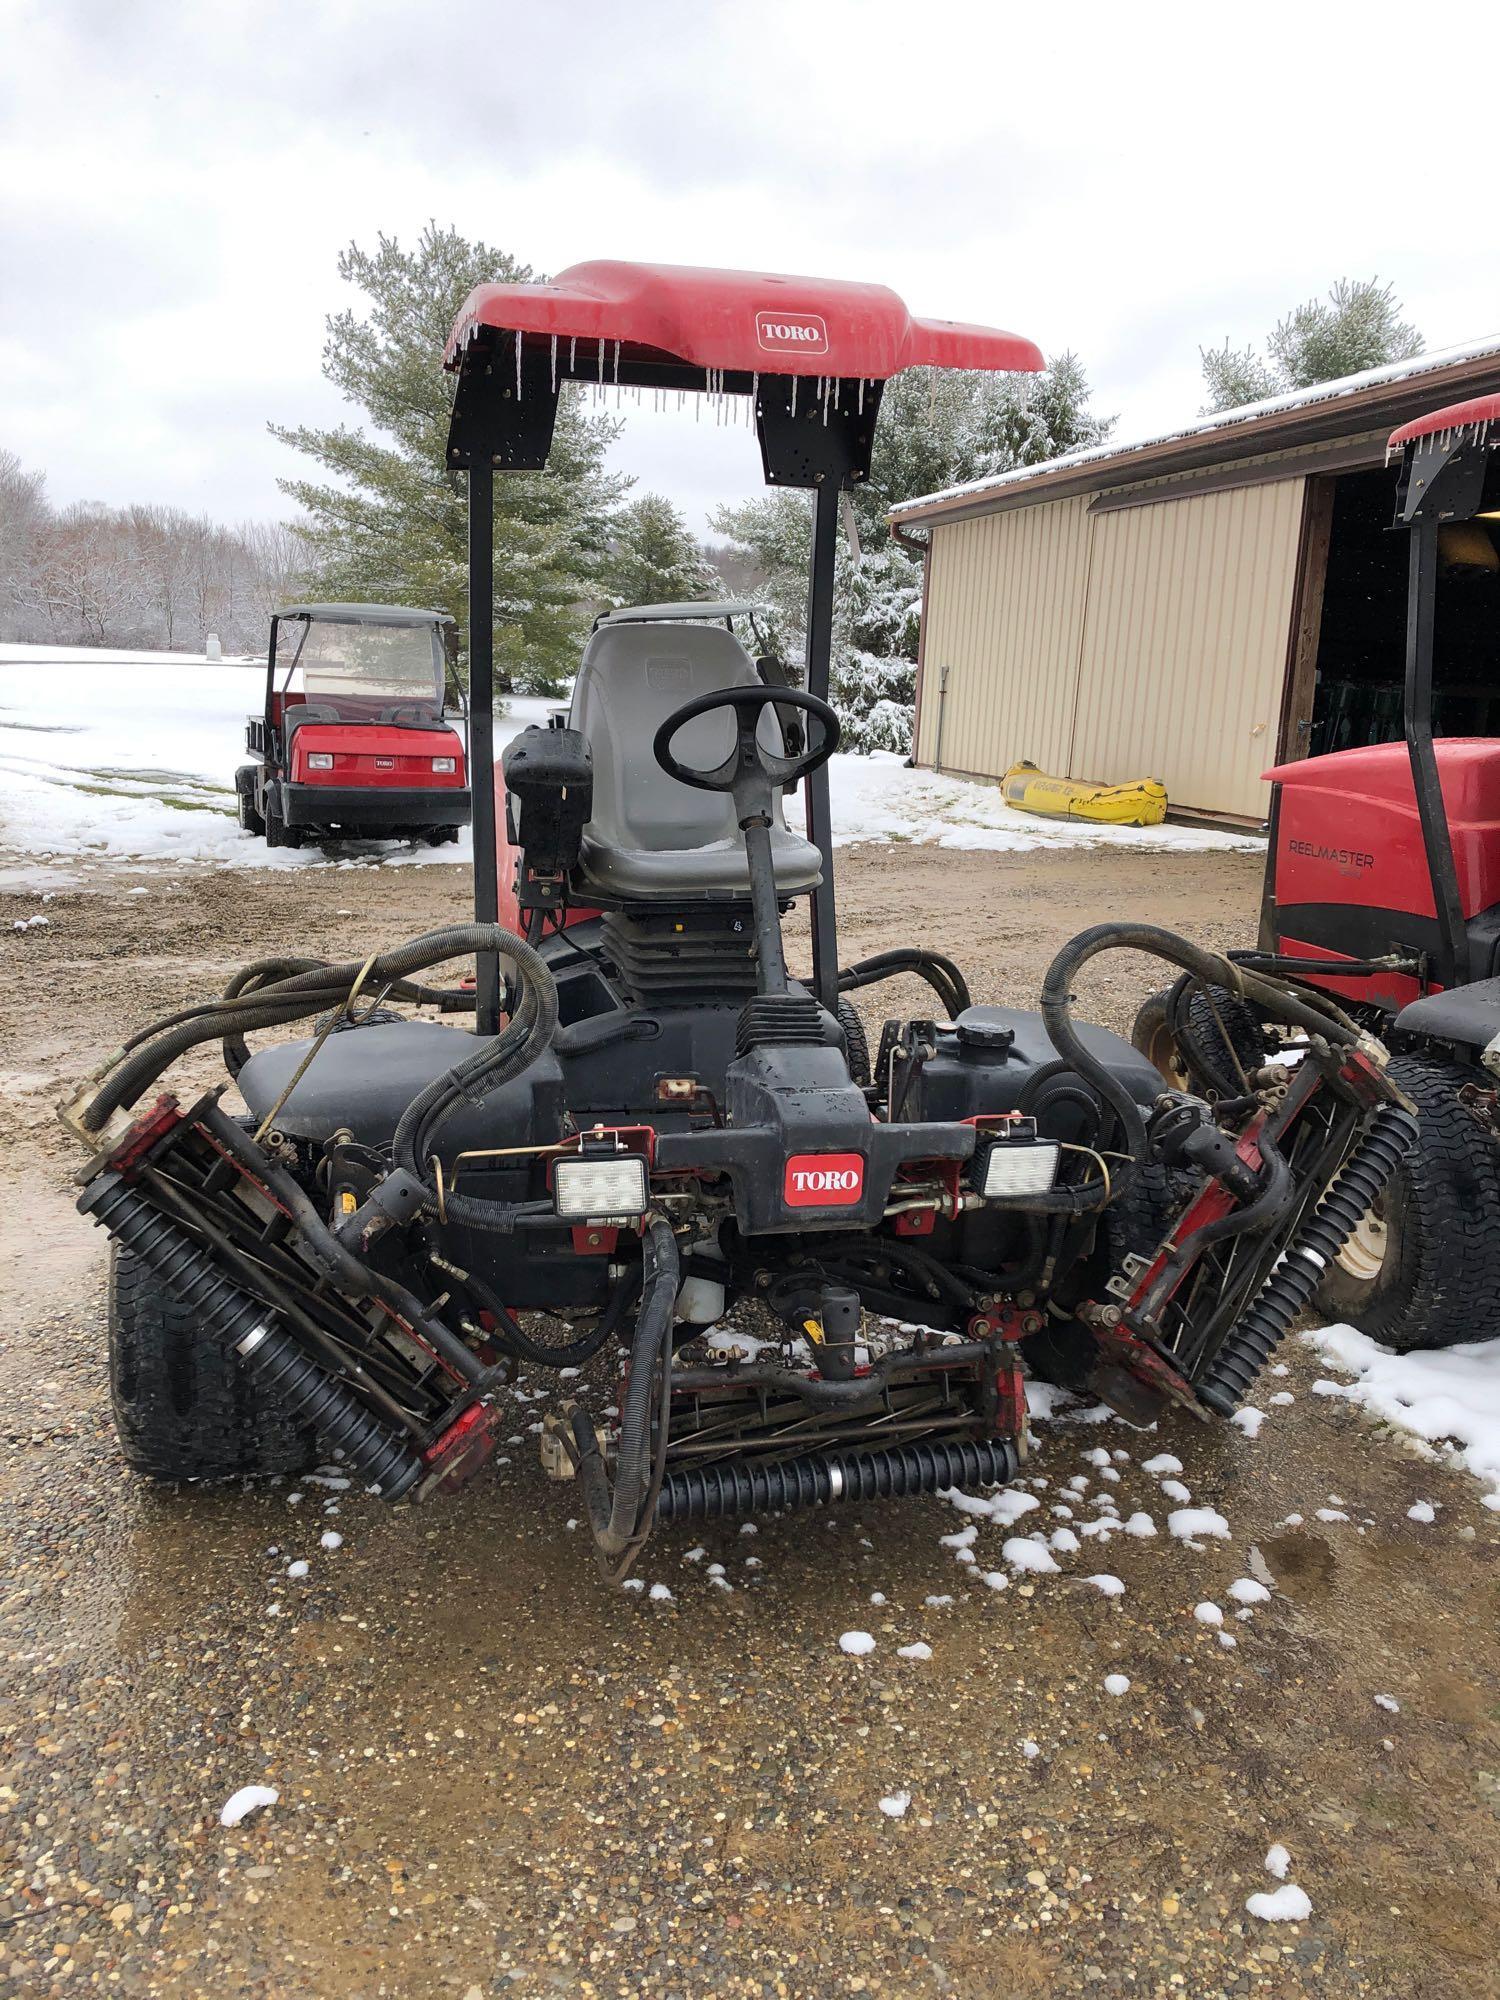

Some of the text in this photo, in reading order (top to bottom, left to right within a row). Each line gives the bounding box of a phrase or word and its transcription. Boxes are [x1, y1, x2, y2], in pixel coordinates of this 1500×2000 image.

[761, 323, 820, 342] TORO
[1288, 839, 1375, 870] REELMASTER
[792, 1170, 860, 1192] TORO
